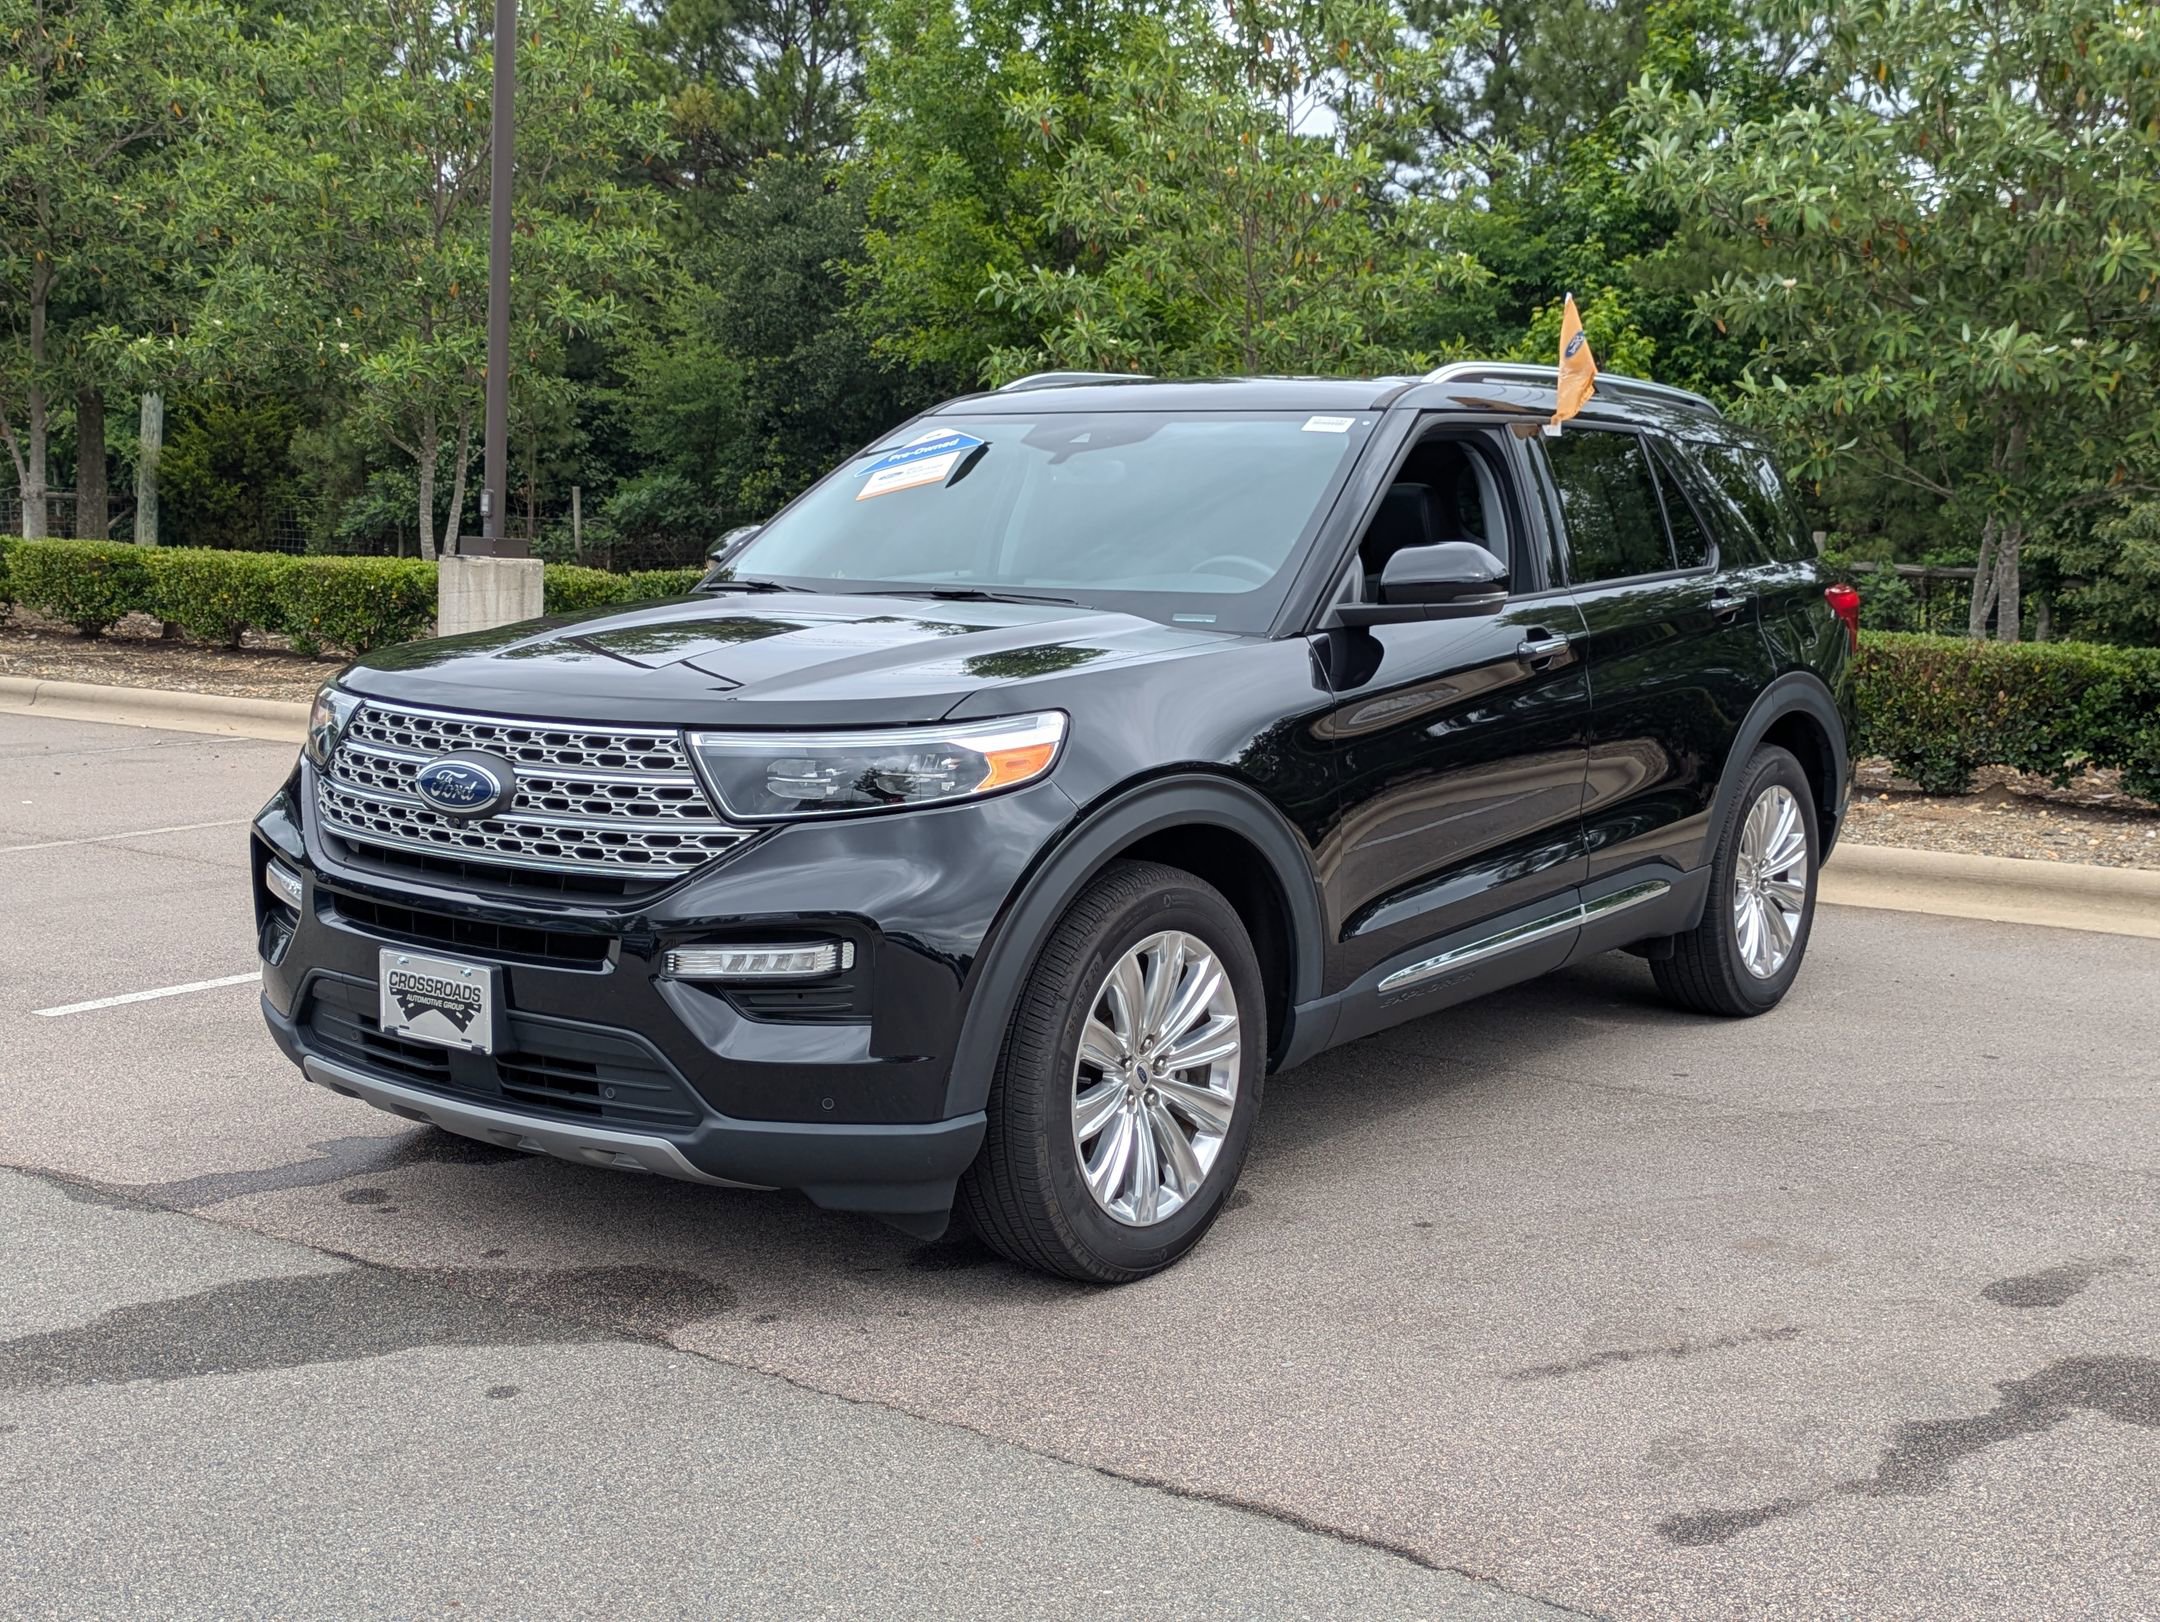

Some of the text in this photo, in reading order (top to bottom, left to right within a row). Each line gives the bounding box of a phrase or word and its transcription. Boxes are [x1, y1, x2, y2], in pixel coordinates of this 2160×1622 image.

[888, 438, 960, 462] Pre-Owned
[430, 769, 478, 801] Ford
[389, 971, 482, 1003] CROSSROADS
[406, 993, 465, 1011] AUTOMOTIVE GROUP
